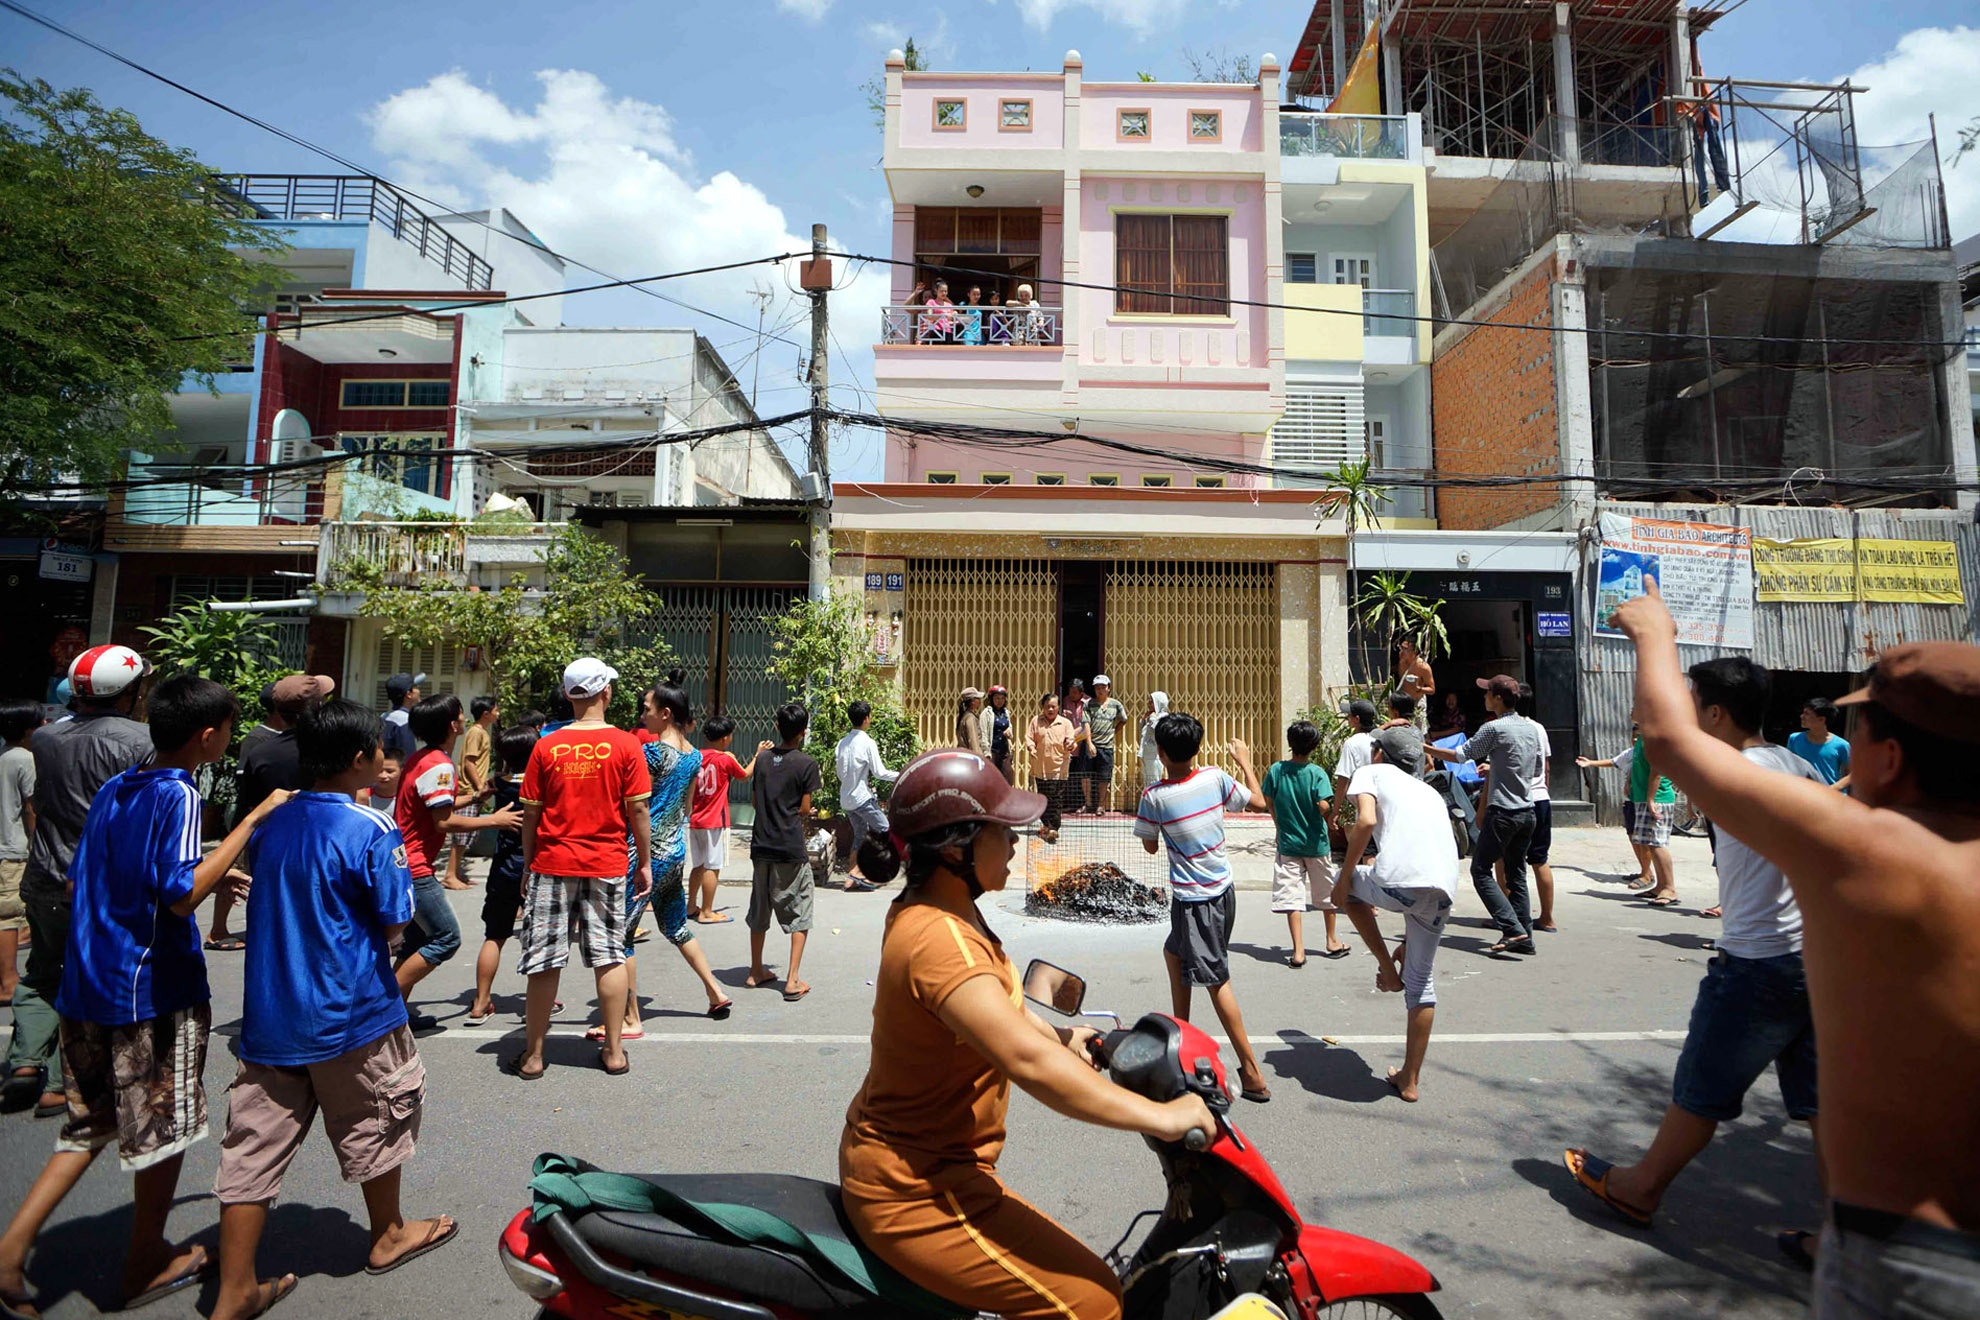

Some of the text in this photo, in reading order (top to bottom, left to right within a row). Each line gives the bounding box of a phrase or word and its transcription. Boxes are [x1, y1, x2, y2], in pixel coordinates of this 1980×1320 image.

[1657, 527, 1675, 540] GIA
[1701, 531, 1748, 545] ARCHITECTS
[1601, 539, 1749, 561] www.tinhgiabao.com.vn
[57, 562, 77, 573] 181
[867, 574, 882, 586] 189
[887, 574, 902, 586] 191
[1546, 586, 1561, 595] 193
[550, 742, 612, 761] PRO
